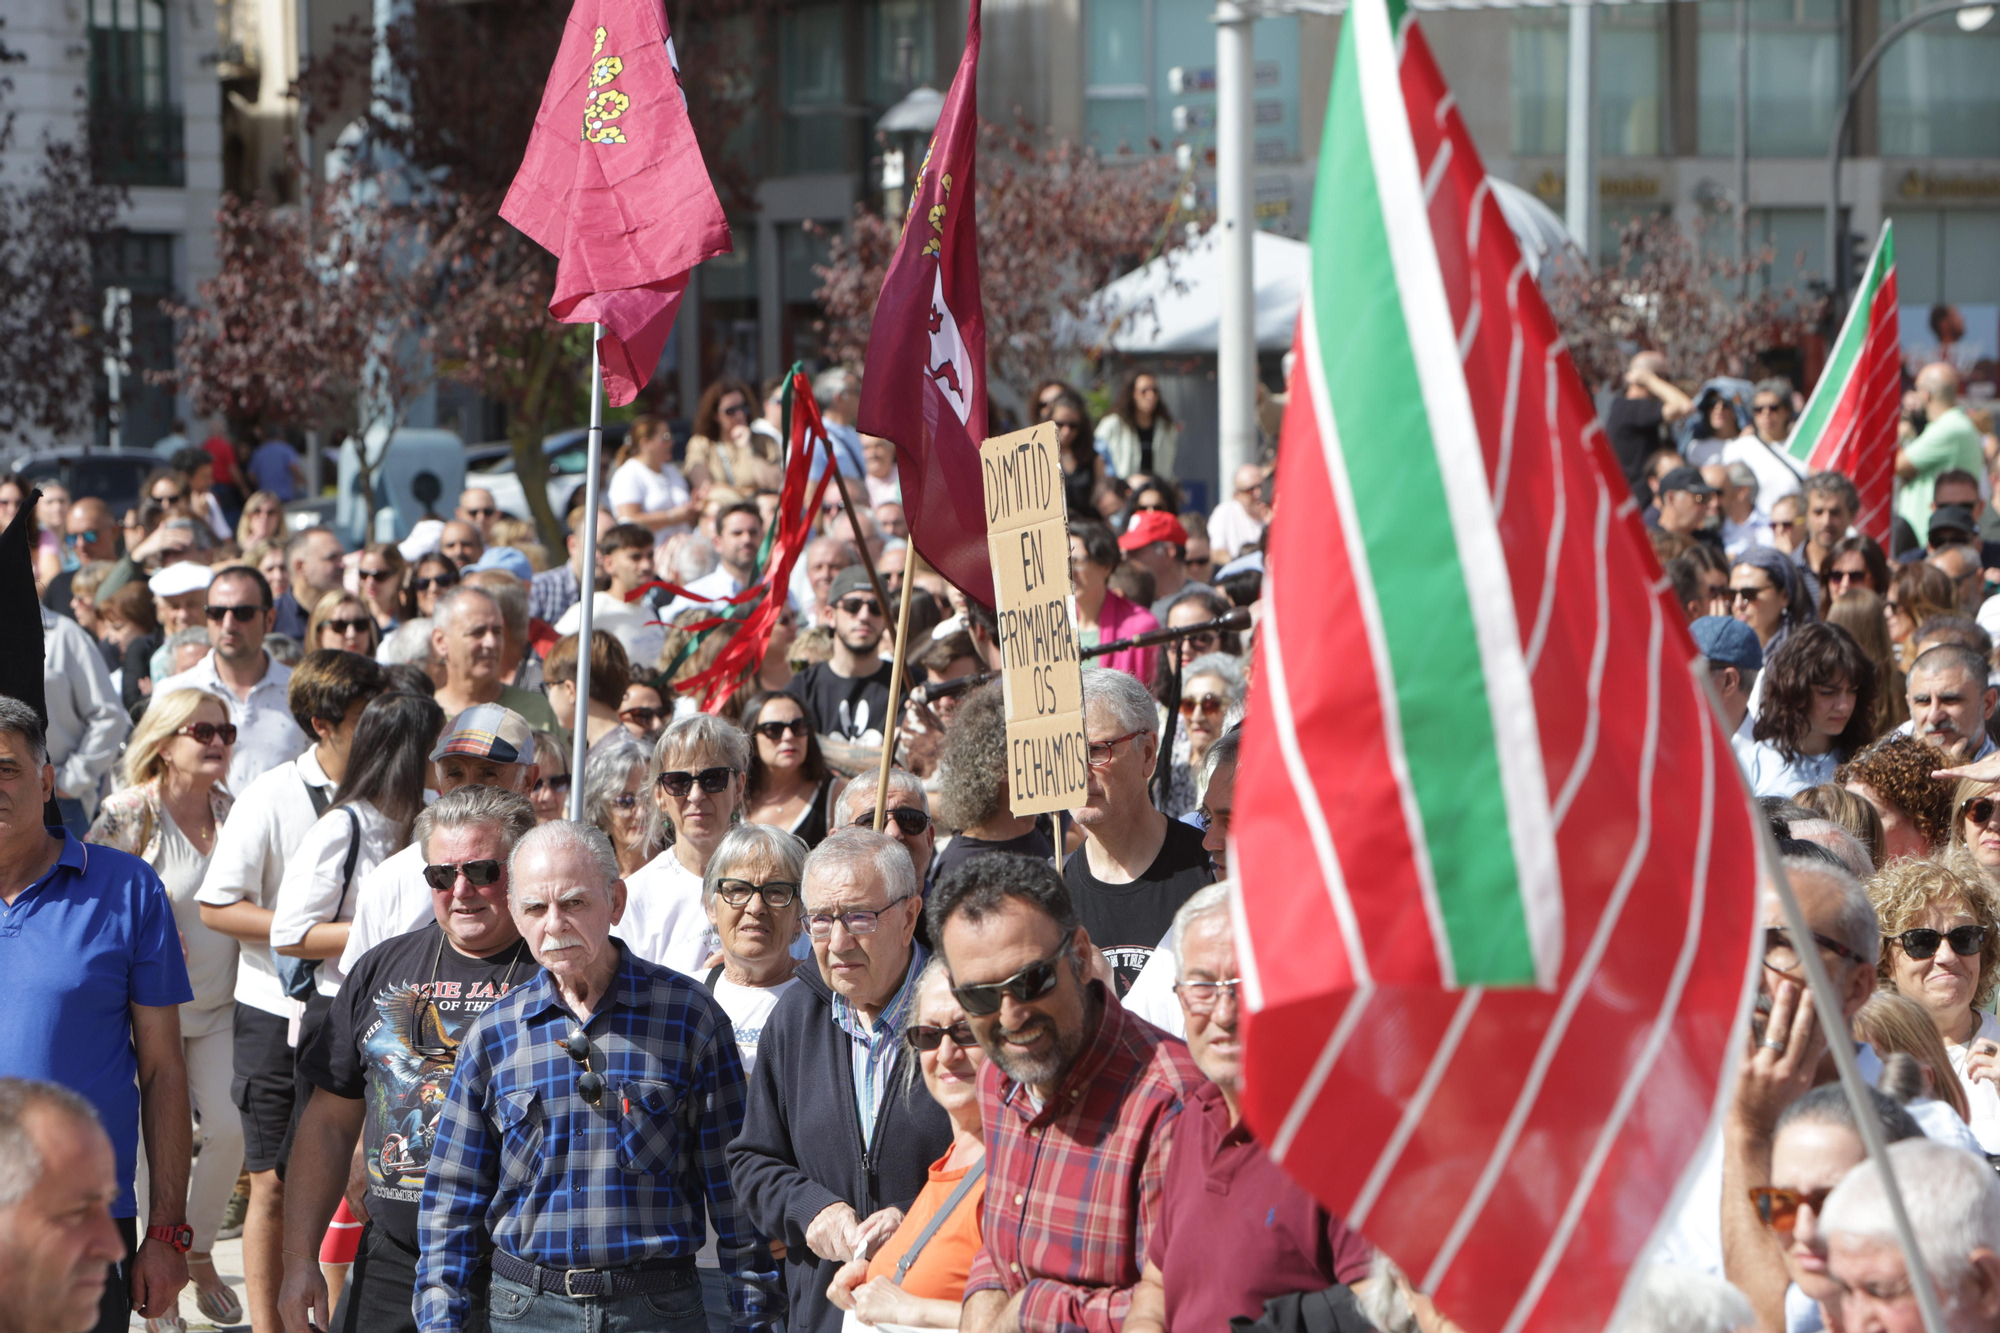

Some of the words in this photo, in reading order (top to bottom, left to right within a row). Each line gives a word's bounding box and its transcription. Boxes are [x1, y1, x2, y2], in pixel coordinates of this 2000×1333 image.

[1021, 529, 1044, 592] EN
[1034, 665, 1056, 714] OS
[1014, 731, 1085, 800] ECHAMOS
[439, 1001, 461, 1012] OF
[362, 1019, 383, 1045] THE
